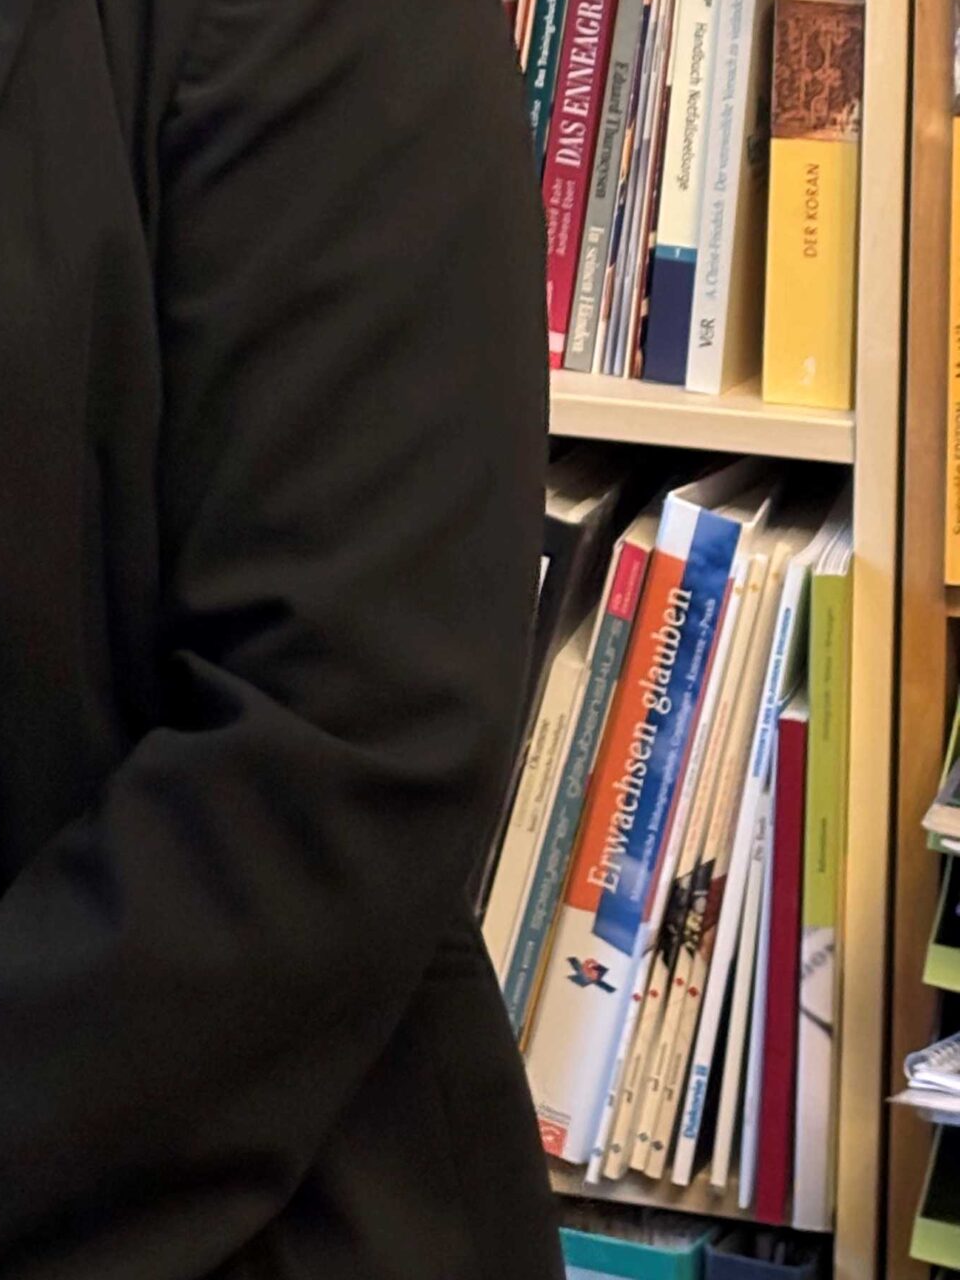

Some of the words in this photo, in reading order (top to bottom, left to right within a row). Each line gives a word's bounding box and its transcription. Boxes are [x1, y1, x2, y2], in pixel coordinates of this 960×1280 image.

[689, 22, 707, 84] Handbuch
[608, 62, 628, 118] Eduard
[555, 119, 588, 168] DAS
[594, 120, 619, 200] Thurneysen
[678, 86, 702, 192] Notfallseelsorge
[713, 170, 729, 193] Der
[805, 163, 821, 230] KORAN
[588, 226, 605, 243] In
[804, 234, 817, 259] DER
[583, 245, 601, 291] seinen
[700, 317, 715, 349] V&R
[587, 721, 658, 895] Erwachsen
[639, 586, 692, 716] glauben
[531, 806, 569, 930] speyerer
[566, 620, 623, 800] glaubenskurs
